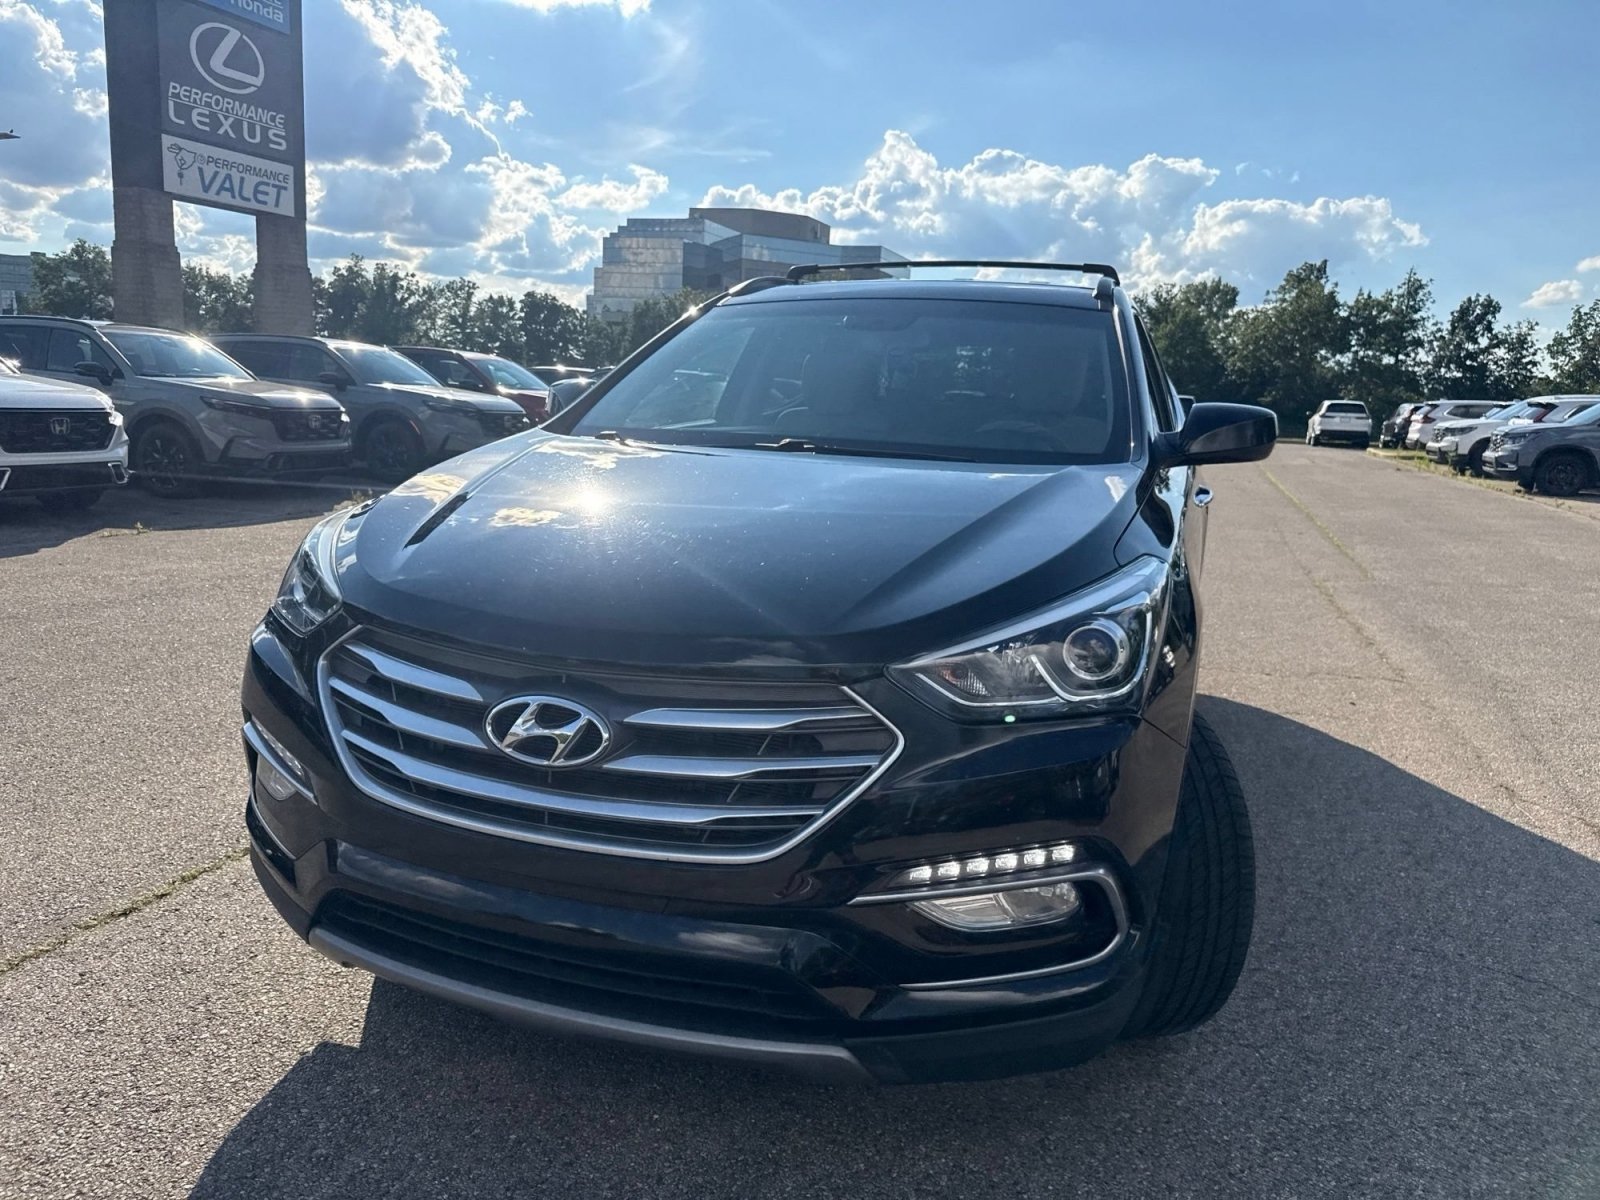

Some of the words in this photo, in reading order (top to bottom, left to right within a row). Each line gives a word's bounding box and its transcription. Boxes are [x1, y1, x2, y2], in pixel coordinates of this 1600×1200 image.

[168, 81, 286, 128] PERFORMANCE
[168, 99, 287, 150] LEXUS
[198, 166, 288, 208] VALET
[206, 155, 290, 185] PERFORMANCE
